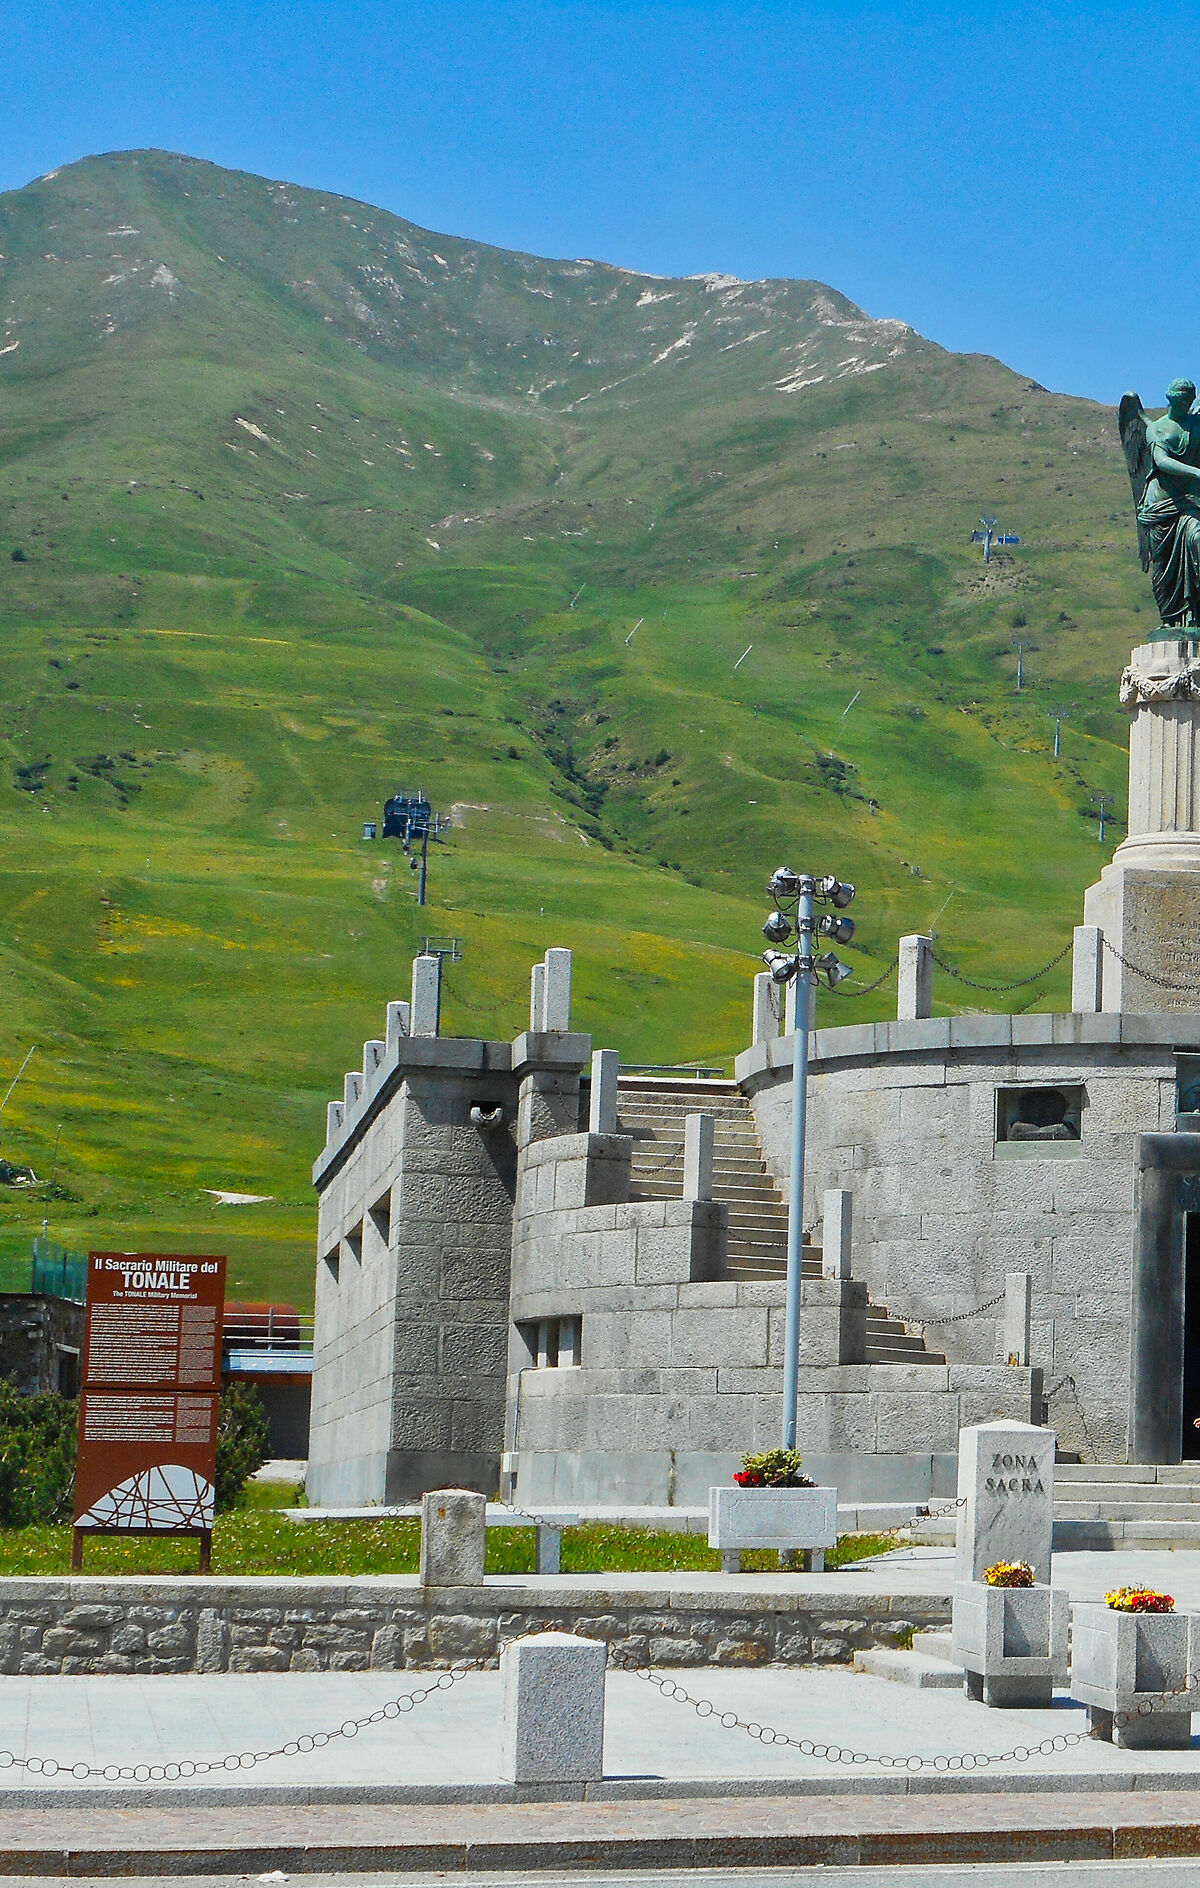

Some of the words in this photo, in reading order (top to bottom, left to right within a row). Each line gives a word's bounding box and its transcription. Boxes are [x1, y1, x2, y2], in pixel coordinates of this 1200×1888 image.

[95, 1258, 102, 1270] Il
[105, 1258, 153, 1272] Sacrario
[155, 1260, 198, 1273] Militare
[200, 1262, 218, 1274] del
[122, 1272, 190, 1290] TONALE
[125, 1290, 147, 1298] TONALE
[148, 1291, 169, 1299] Military
[991, 1453, 1039, 1470] ZONA
[984, 1477, 1045, 1492] SACRA
